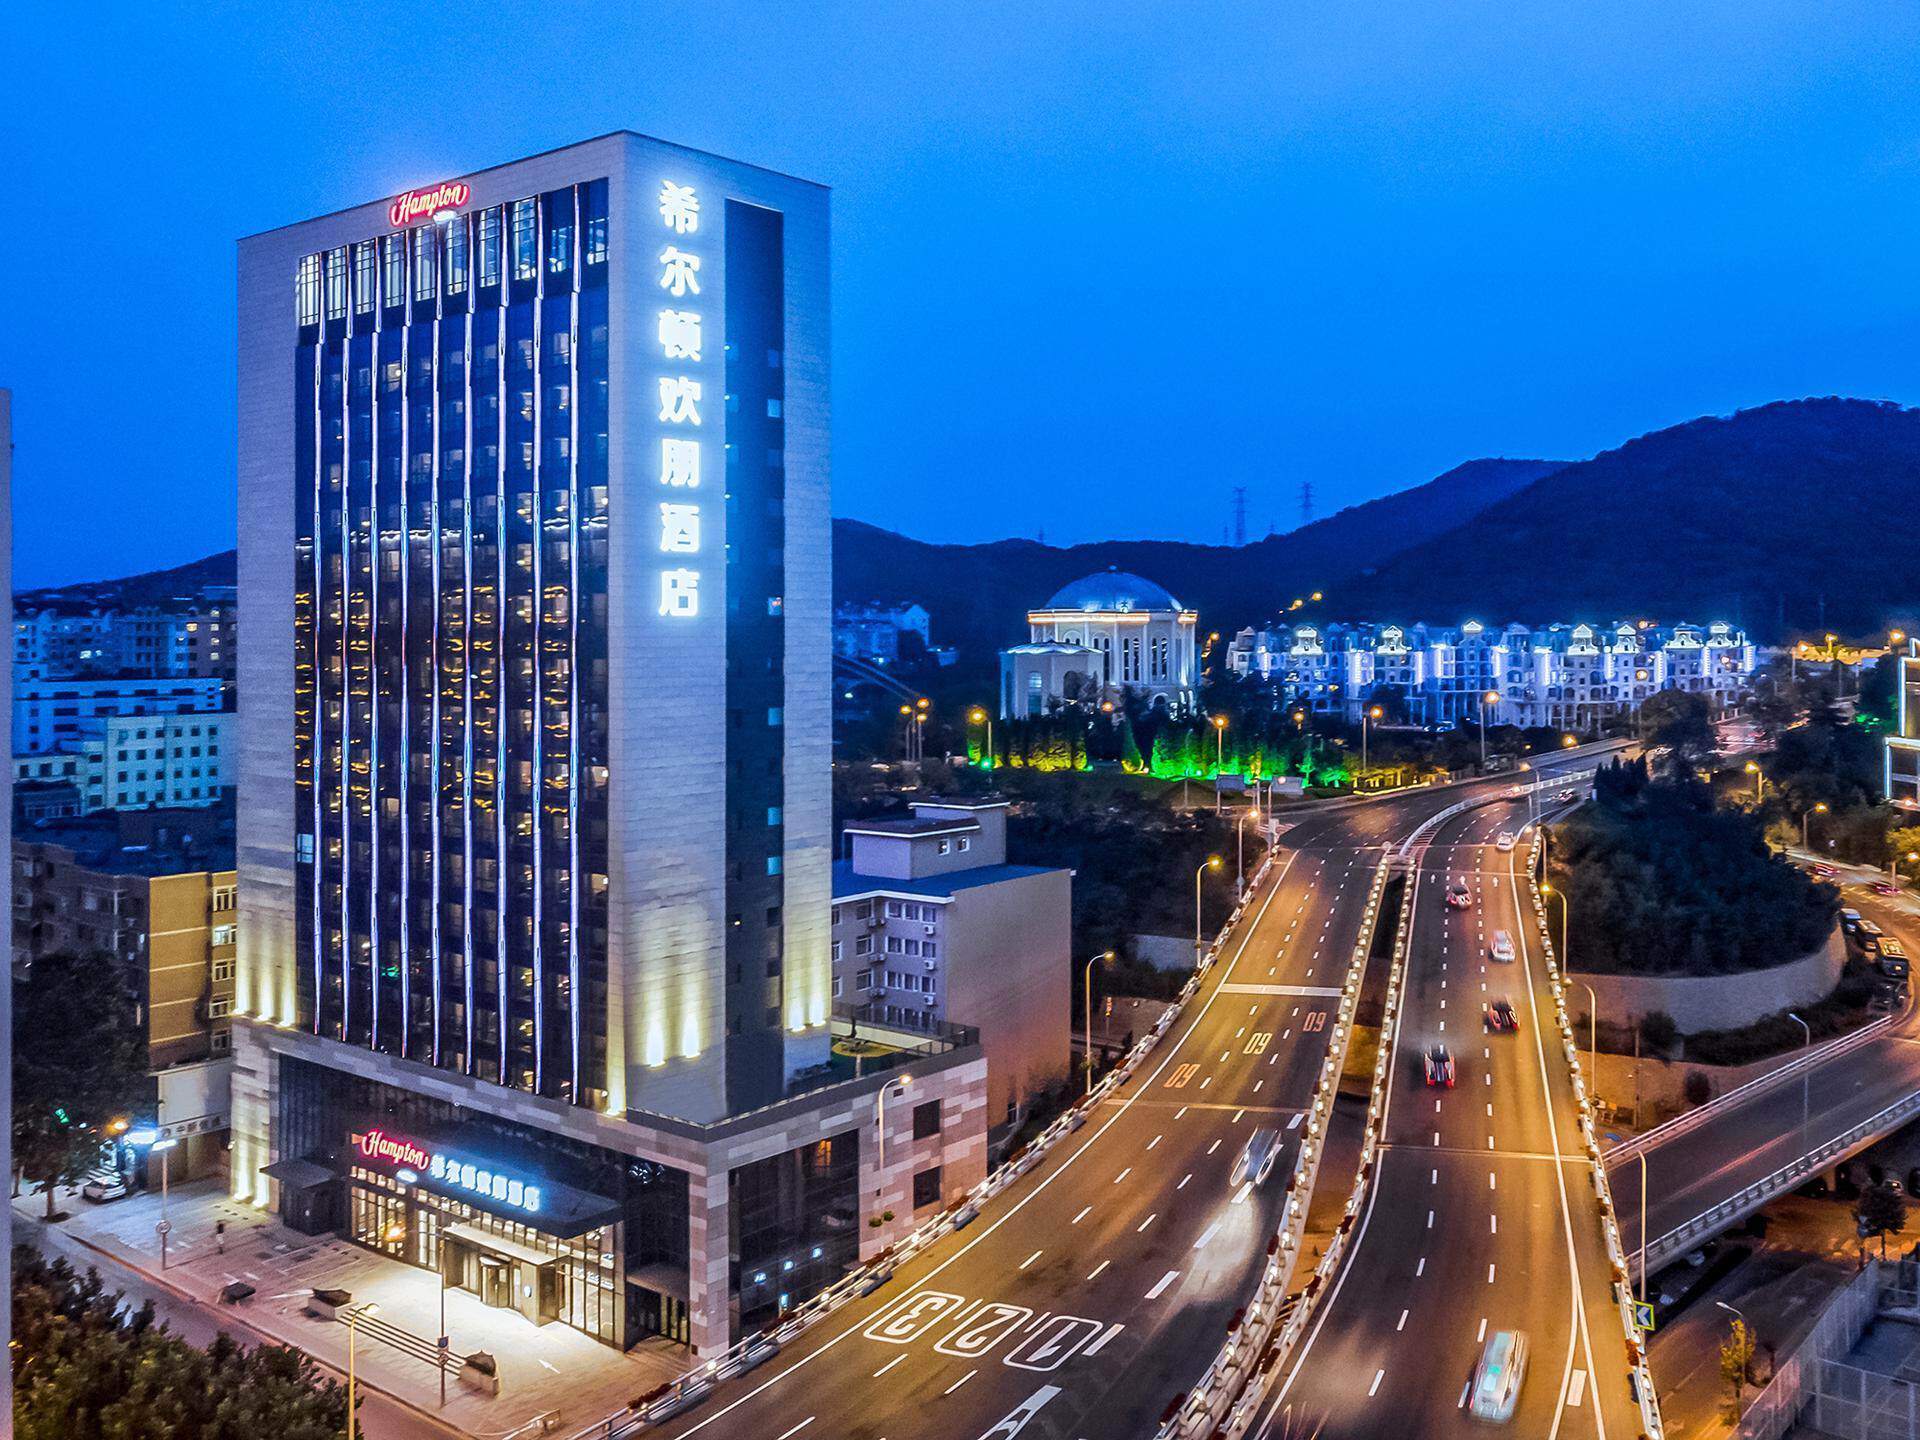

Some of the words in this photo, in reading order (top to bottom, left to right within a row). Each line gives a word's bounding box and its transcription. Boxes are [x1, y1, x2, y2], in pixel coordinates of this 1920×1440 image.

[390, 184, 468, 226] Hampton
[659, 180, 701, 617] 希尔顿欢朋酒店
[361, 1130, 429, 1170] Hampton
[884, 1297, 947, 1336] 3
[956, 1308, 1020, 1348] 2
[1026, 1321, 1079, 1362] 1
